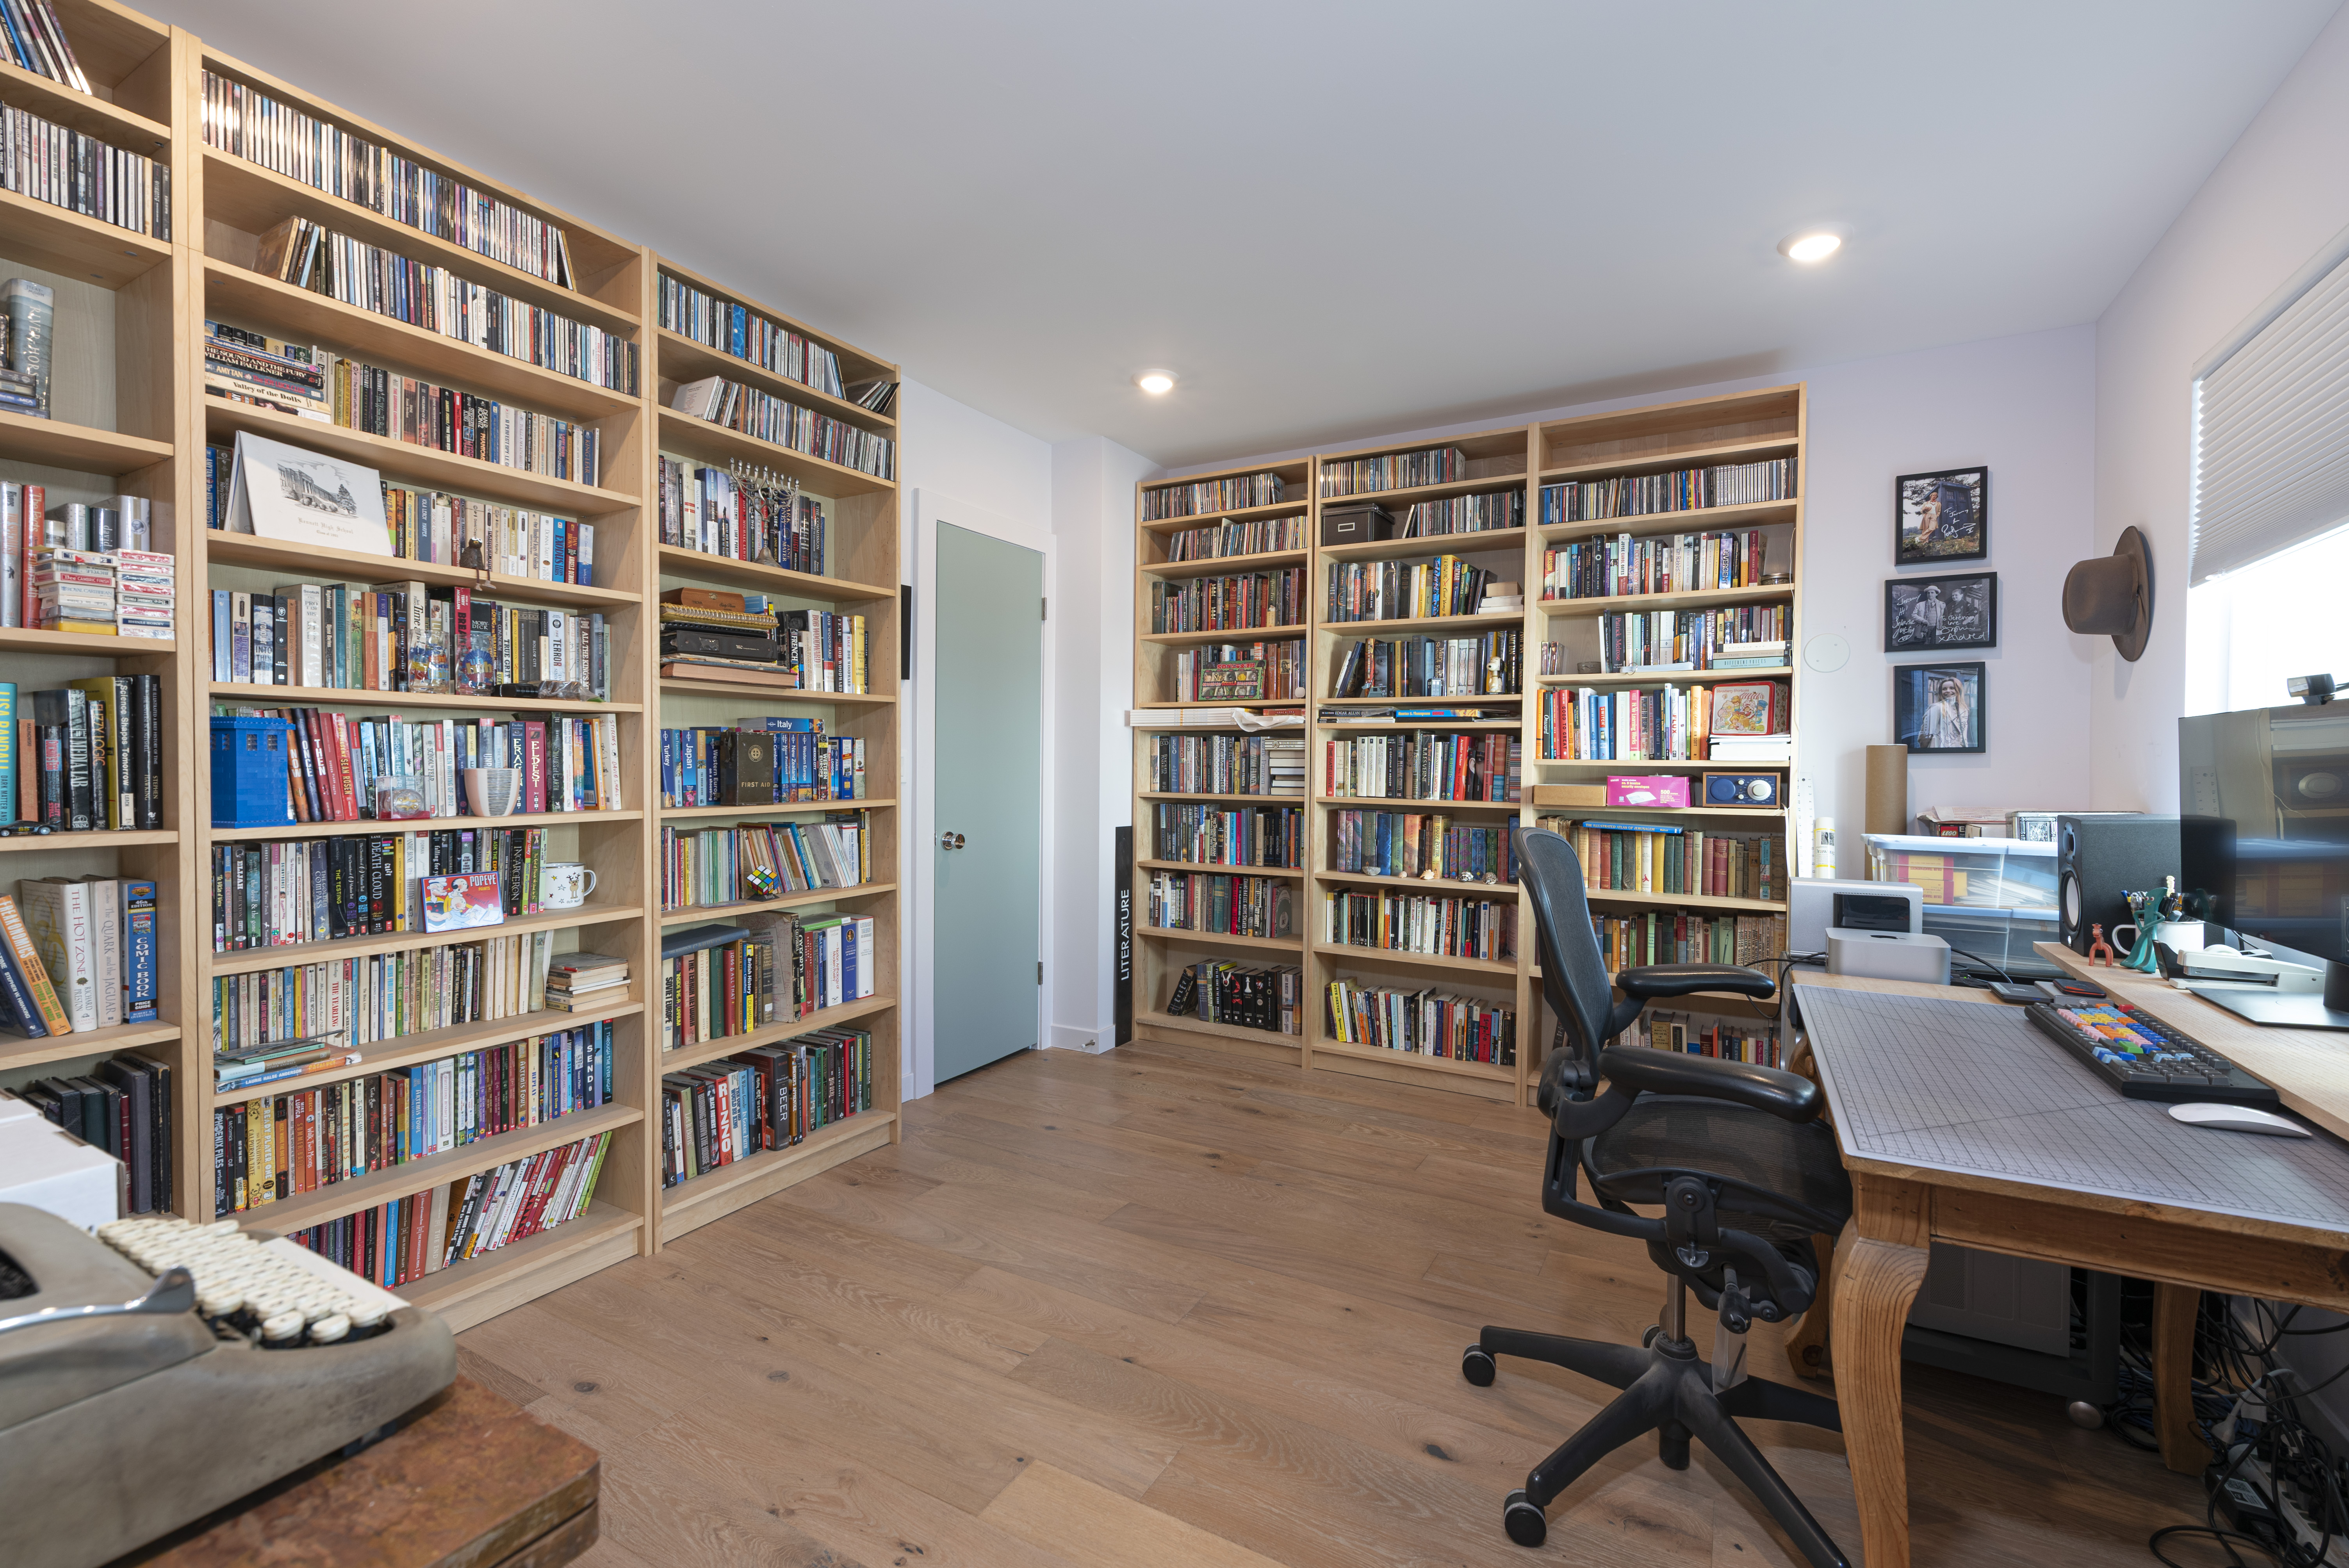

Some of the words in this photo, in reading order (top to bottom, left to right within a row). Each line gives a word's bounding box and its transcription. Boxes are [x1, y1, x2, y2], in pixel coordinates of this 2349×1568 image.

[217, 366, 231, 375] AMY
[231, 369, 243, 378] TAN
[219, 350, 249, 362] SOUND
[250, 359, 270, 368] AND
[269, 363, 285, 371] THE
[286, 368, 306, 378] FURY
[240, 362, 283, 377] FAULKNER
[233, 381, 255, 393] Valley
[281, 394, 302, 403] Dolls
[555, 535, 564, 563] EXODUS
[1896, 593, 1921, 606] Jeremy
[553, 639, 562, 666] TERROR
[120, 686, 128, 714] Science
[121, 717, 129, 745] Shapes
[777, 720, 792, 730] Italy
[121, 748, 130, 786] Tomorrow
[290, 750, 301, 778] NOW
[302, 741, 313, 777] ONCE
[314, 739, 326, 775] THEN
[340, 759, 349, 773] SEAN
[531, 741, 540, 788] ELDEST
[343, 776, 352, 795] ROSEN
[372, 842, 380, 869] DEATH
[470, 875, 497, 887] POPEYE
[511, 846, 520, 897] INCARCERON
[372, 873, 382, 899] CLOUD
[72, 889, 80, 913] THE
[0, 901, 34, 958] FREAKONOMICS
[73, 916, 85, 943] HOT
[75, 946, 86, 976] ZONE
[135, 937, 149, 969] COMIC
[5, 972, 17, 992] STEPHEN
[17, 997, 30, 1018] HAWKING
[136, 971, 149, 998] BOOK
[74, 989, 83, 1011] PRESTON
[279, 1069, 302, 1078] ANDERSON
[779, 1087, 788, 1121] BEER
[718, 1083, 731, 1153] RIZZO
[215, 1149, 224, 1169] FILES
